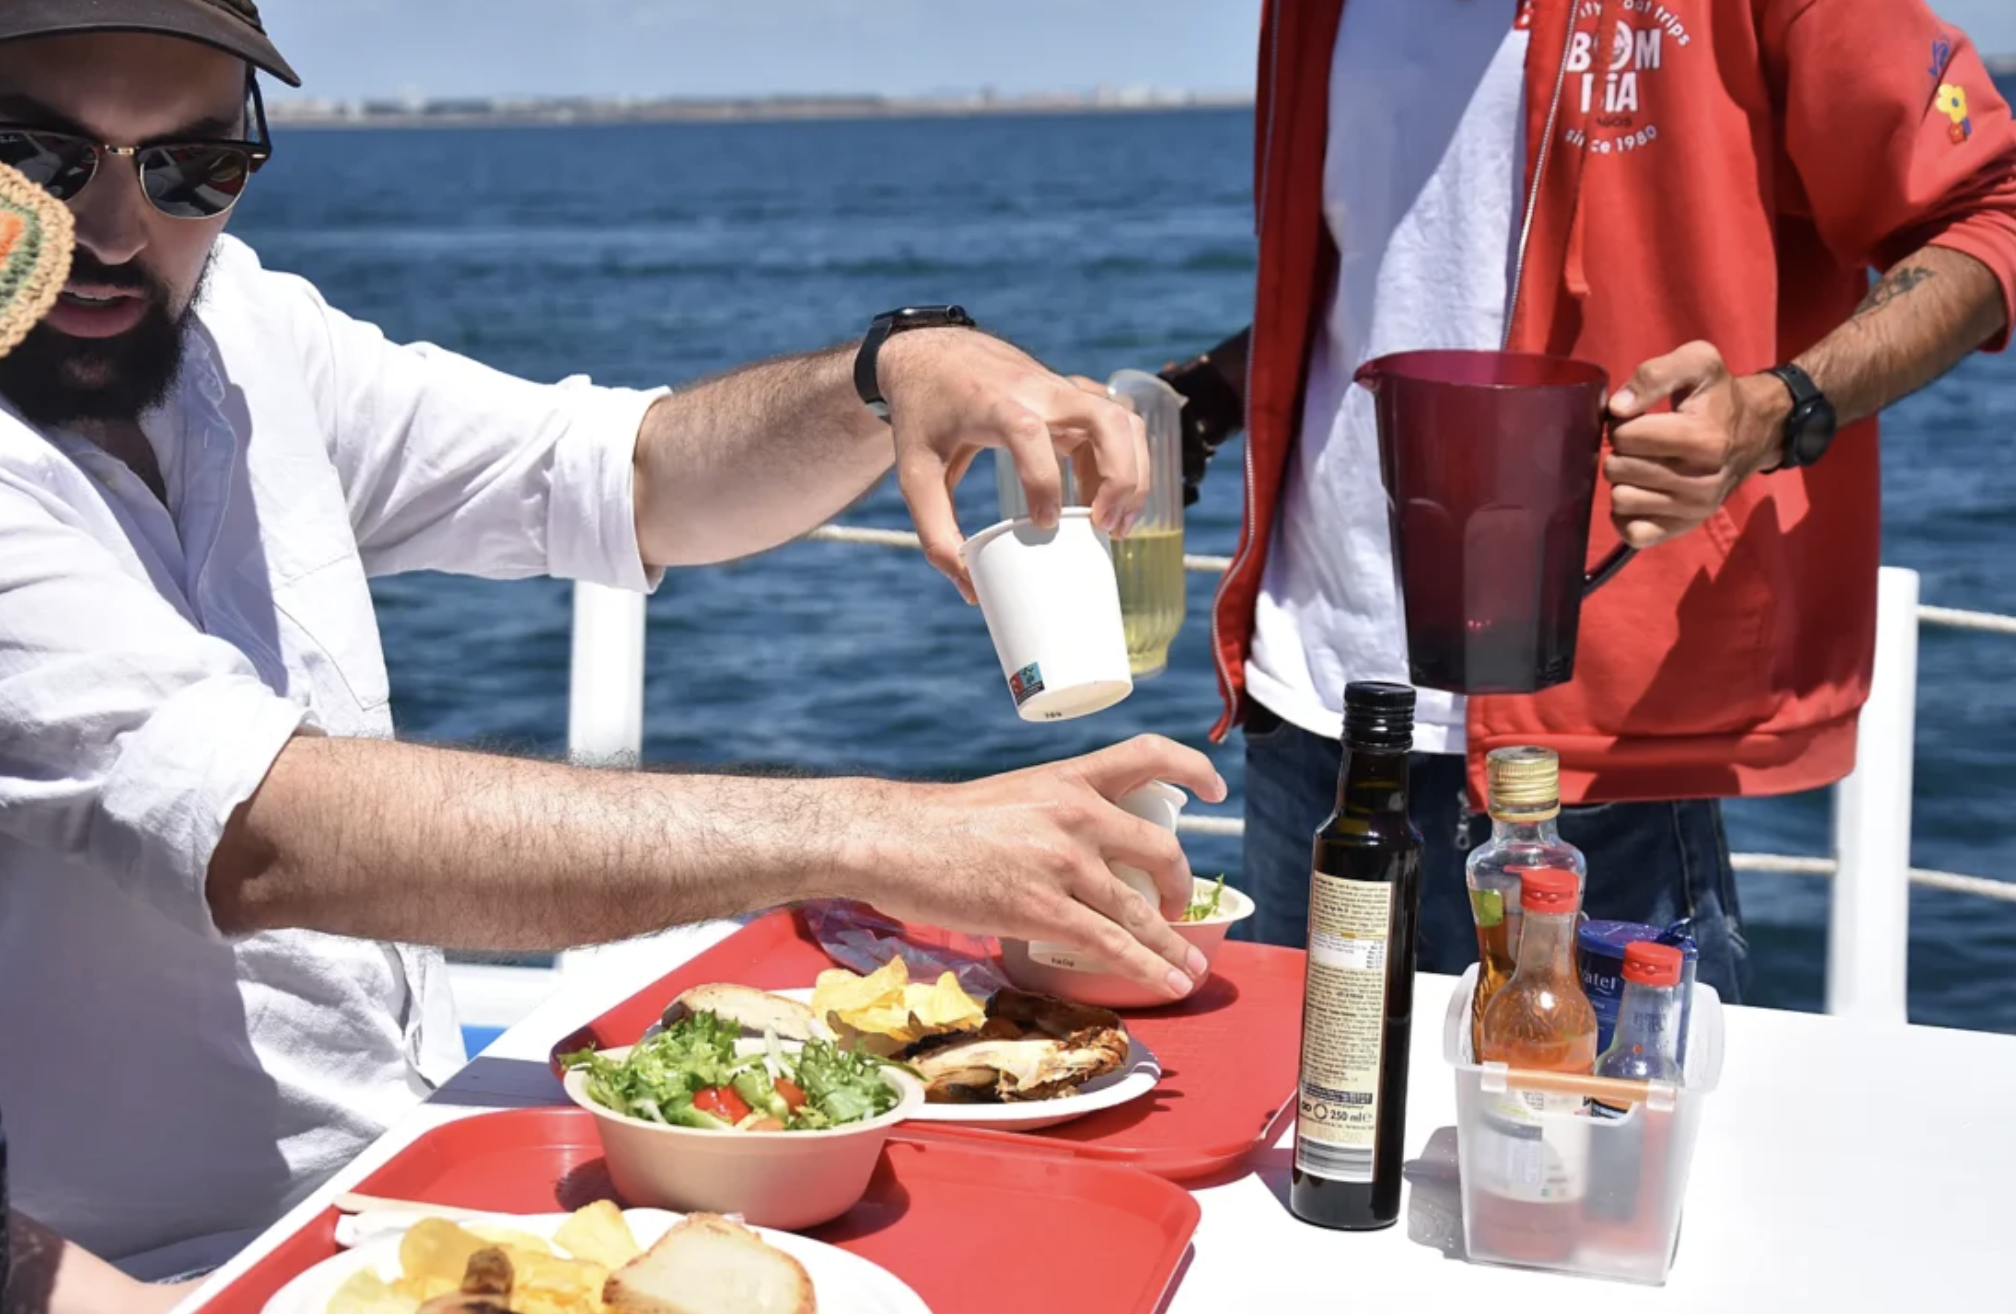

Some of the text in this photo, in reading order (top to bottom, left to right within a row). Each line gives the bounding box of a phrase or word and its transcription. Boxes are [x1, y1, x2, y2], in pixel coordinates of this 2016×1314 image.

[1654, 5, 1691, 46] trips
[1616, 125, 1657, 152] 1980
[1330, 1109, 1348, 1122] 250
